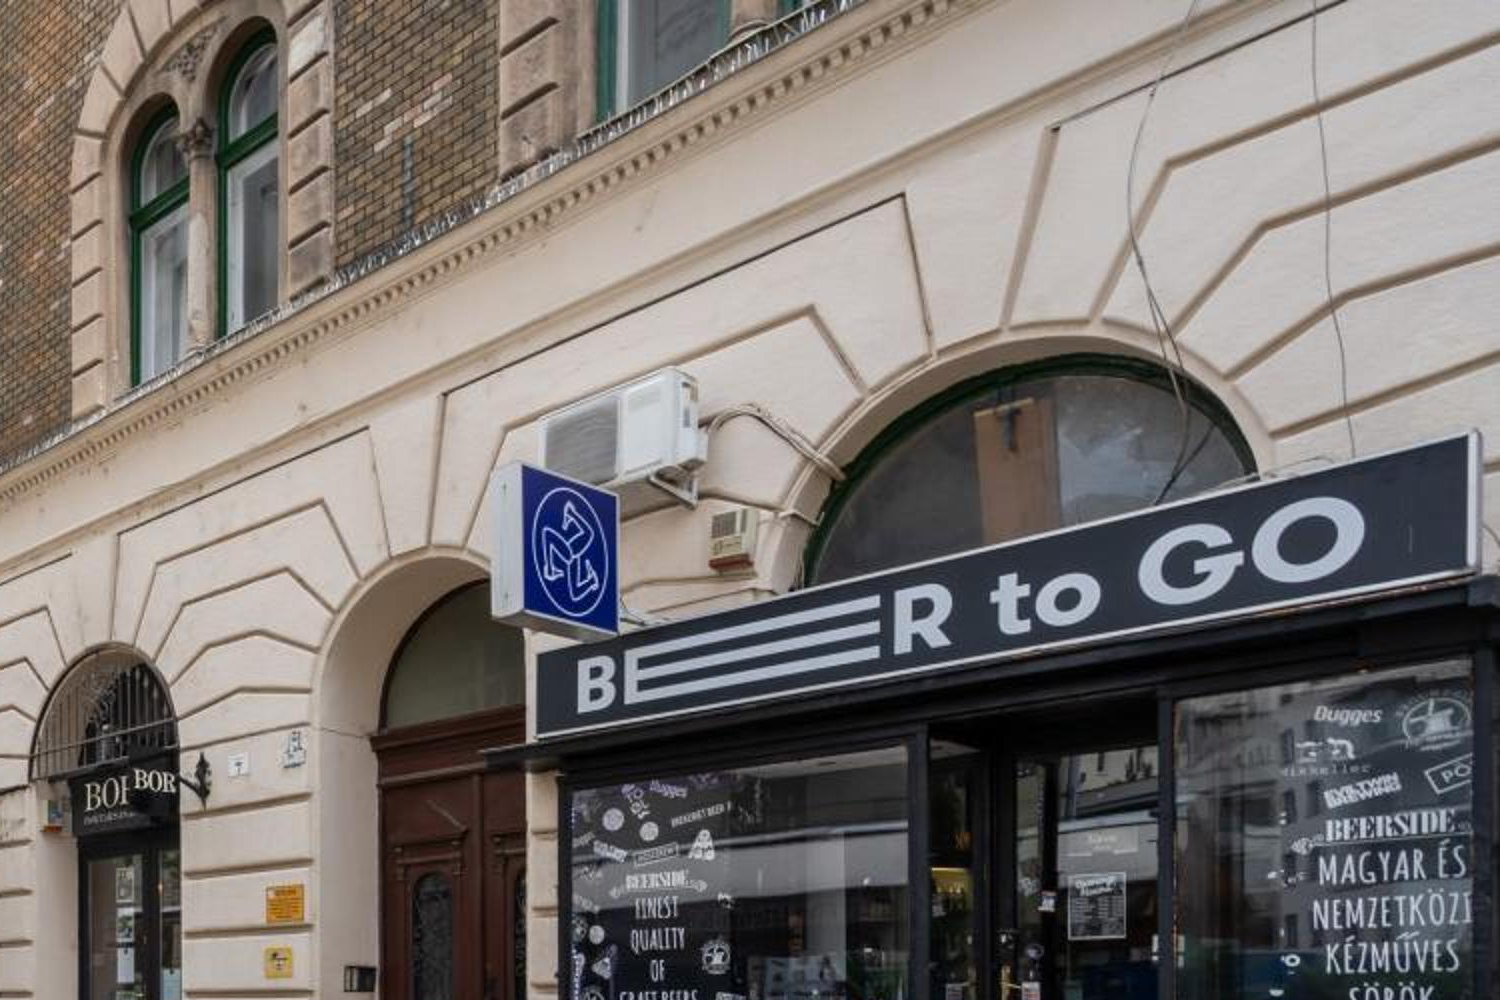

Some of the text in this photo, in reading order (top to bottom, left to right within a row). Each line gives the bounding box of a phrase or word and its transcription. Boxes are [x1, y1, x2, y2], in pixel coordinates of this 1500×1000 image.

[990, 568, 1102, 634] to
[1138, 496, 1366, 605] GO
[1314, 705, 1383, 726] Dugges
[134, 768, 177, 794] BOR
[1325, 808, 1456, 842] BEERSIDE
[1319, 838, 1467, 885] MAGYAR ÉS
[635, 895, 679, 919] FINEST
[1313, 888, 1473, 930] NEMZETKÖZI
[630, 927, 685, 955] QUALITY
[1326, 931, 1460, 975] KÉZMŰVES
[651, 959, 665, 983] OF
